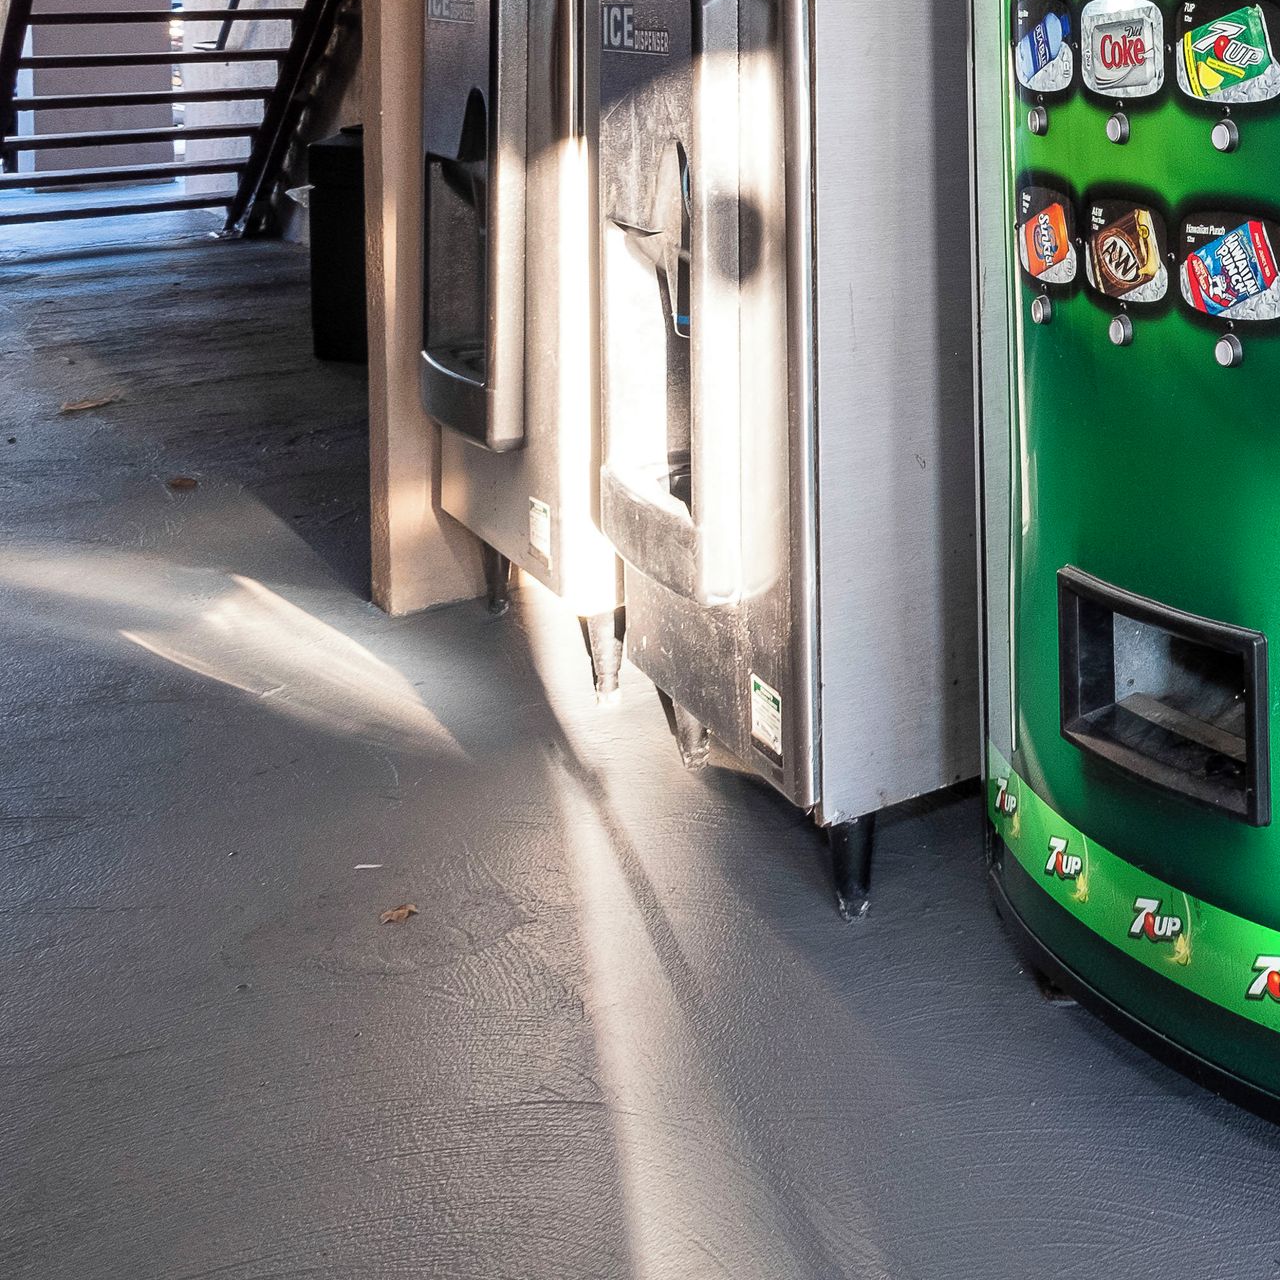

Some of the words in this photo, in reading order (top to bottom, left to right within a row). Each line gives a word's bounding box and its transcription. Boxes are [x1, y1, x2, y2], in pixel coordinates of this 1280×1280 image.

[1184, 2, 1196, 13] 7UP
[603, 5, 634, 47] ICE
[634, 30, 669, 53] DISPENSER
[1192, 21, 1264, 68] 7UP
[1100, 33, 1145, 70] Coke
[1208, 225, 1226, 236] Punch
[1102, 238, 1139, 279] A&W
[1215, 244, 1249, 297] PUNCH
[1224, 231, 1261, 297] HAWAIIAN
[996, 778, 1017, 814] 7UP
[1045, 837, 1081, 878] 7UP
[1129, 898, 1181, 940] 7UP
